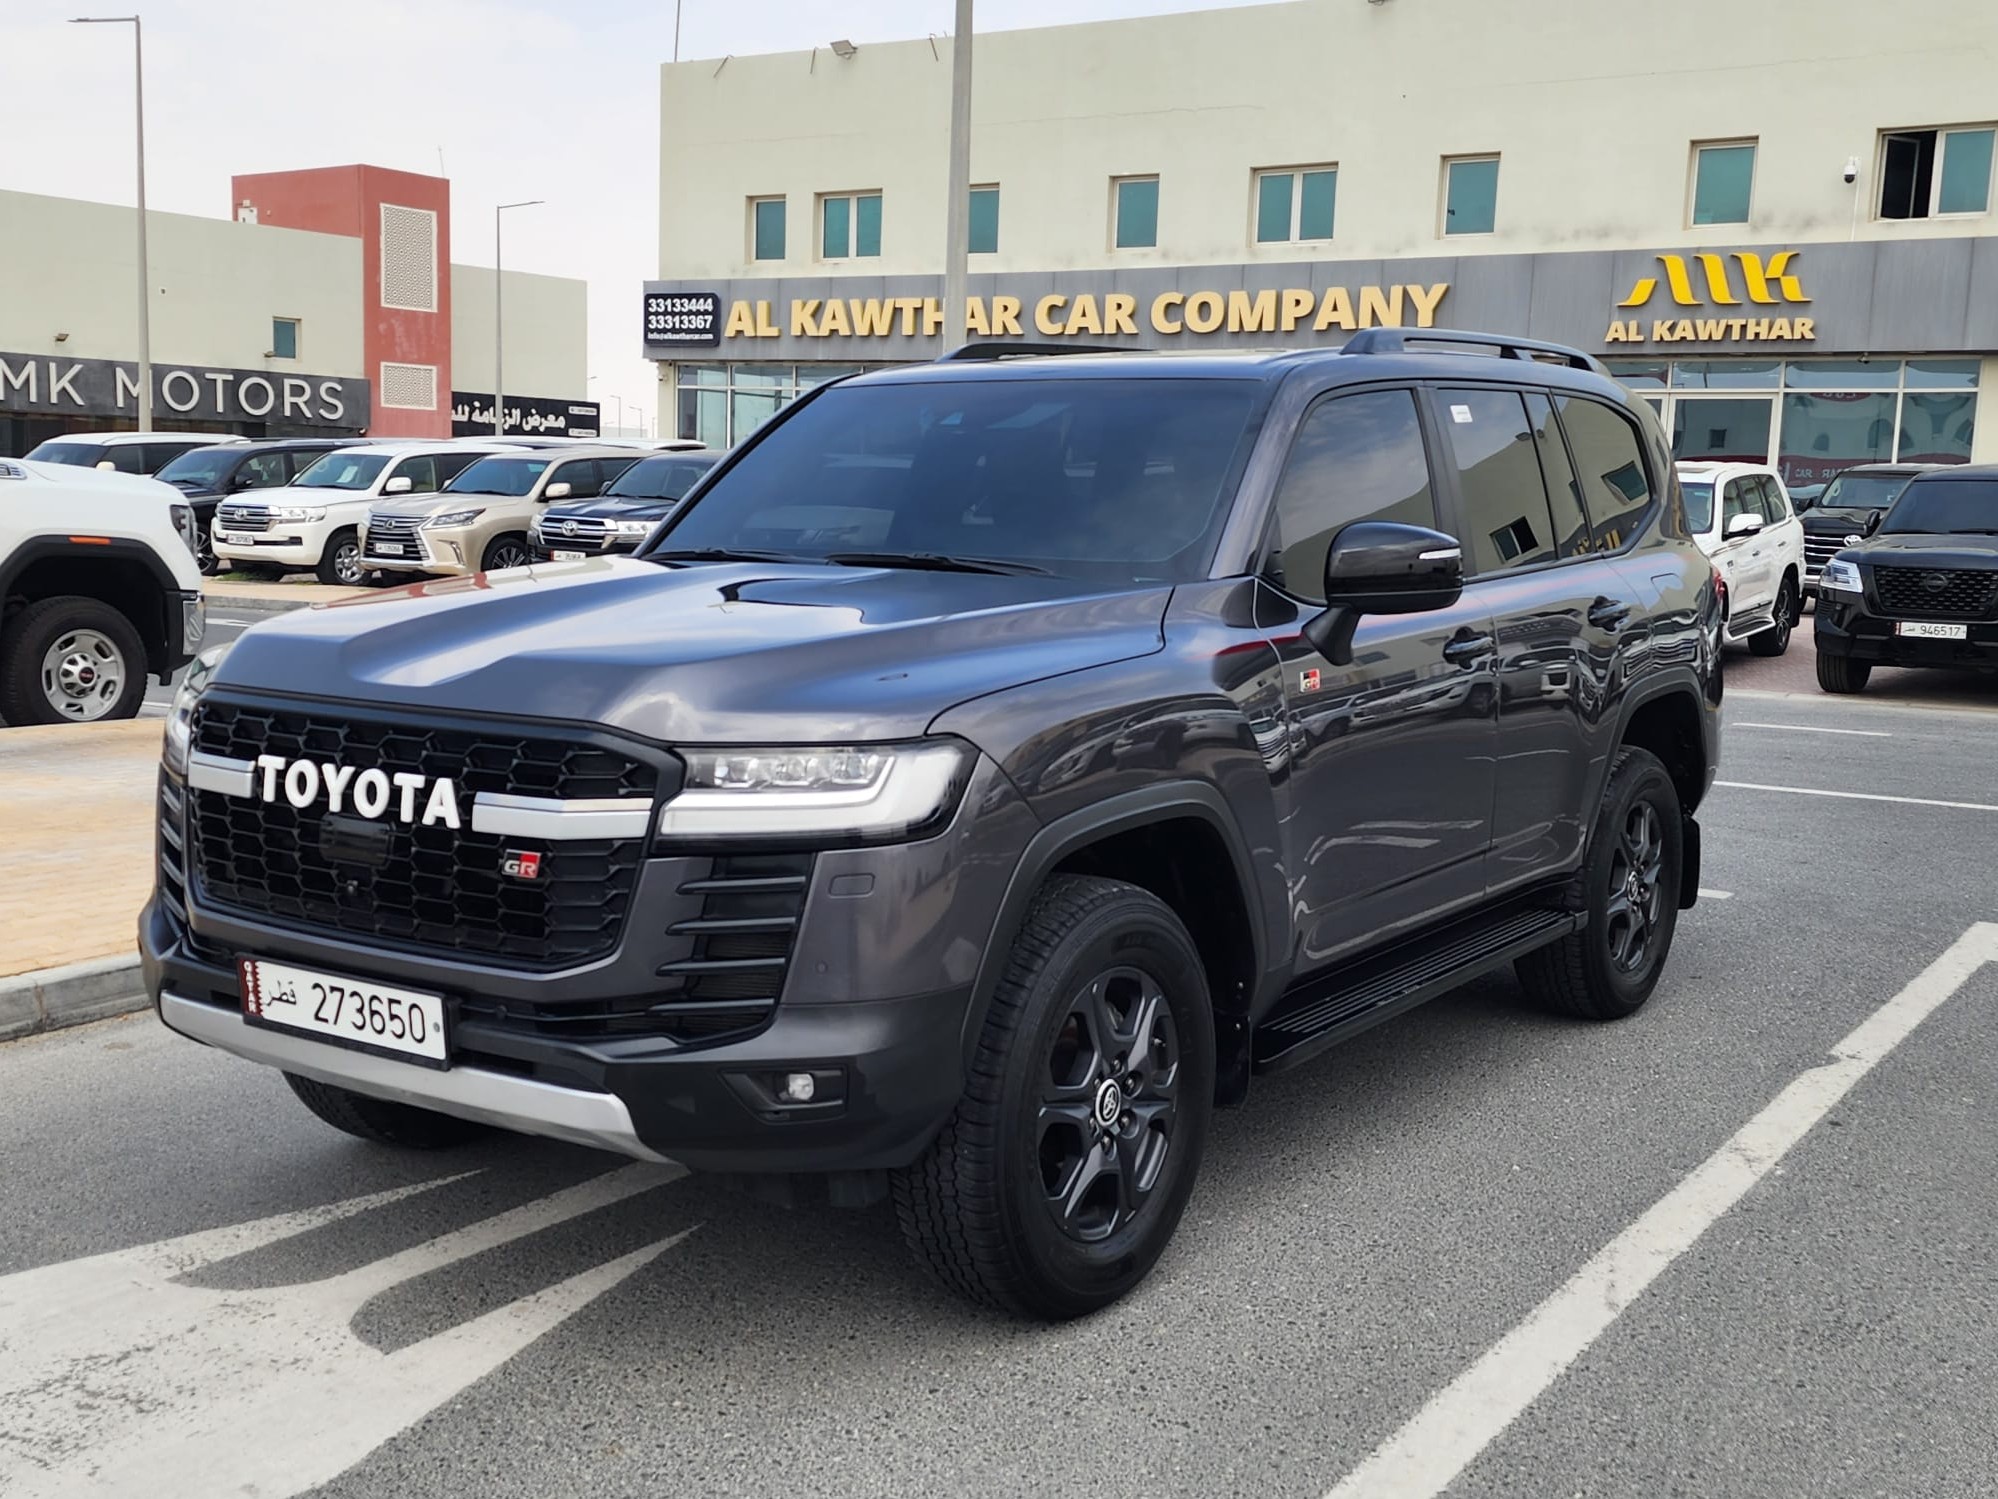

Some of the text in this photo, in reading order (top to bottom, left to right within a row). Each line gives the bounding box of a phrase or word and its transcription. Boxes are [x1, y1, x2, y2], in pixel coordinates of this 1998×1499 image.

[648, 298, 713, 312] 33133444
[724, 283, 1449, 338] AL KAWTHAR CAR COMPANY
[648, 314, 713, 329] 33313367
[1605, 317, 1816, 342] AL KAWTHAR
[0, 358, 345, 420] MK MOTORS
[522, 408, 566, 432] معرض
[1920, 625, 1961, 637] 946517
[258, 754, 461, 829] TOYOTA
[504, 859, 537, 877] GR
[263, 979, 297, 1007] قطر
[312, 983, 426, 1044] 273650
